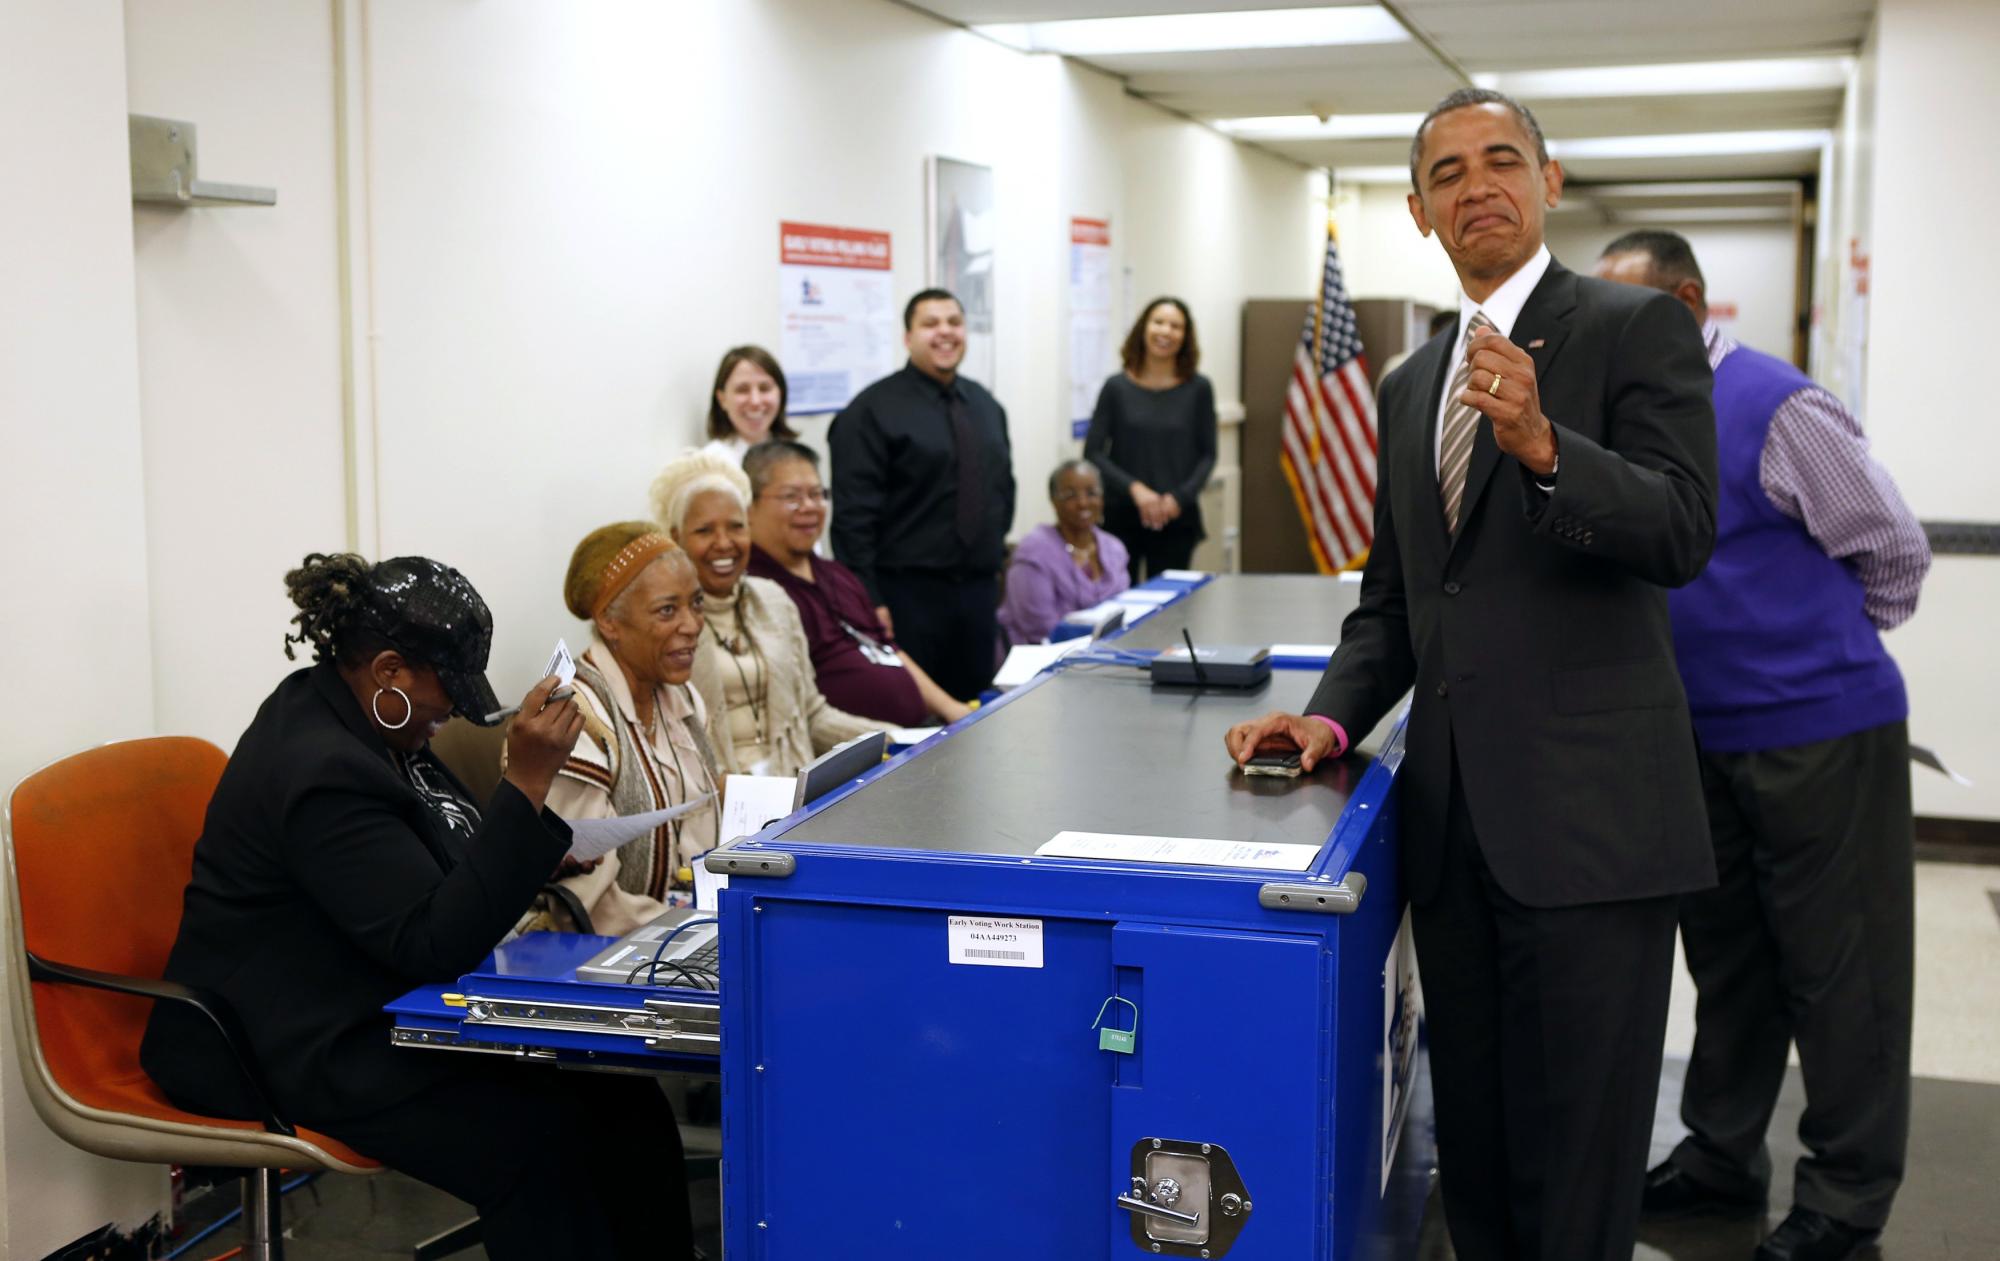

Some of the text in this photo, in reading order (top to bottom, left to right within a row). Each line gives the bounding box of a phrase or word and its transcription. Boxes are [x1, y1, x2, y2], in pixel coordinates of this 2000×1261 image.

[949, 919, 967, 927] Early
[969, 919, 992, 928] Voting
[994, 921, 1014, 929] Work
